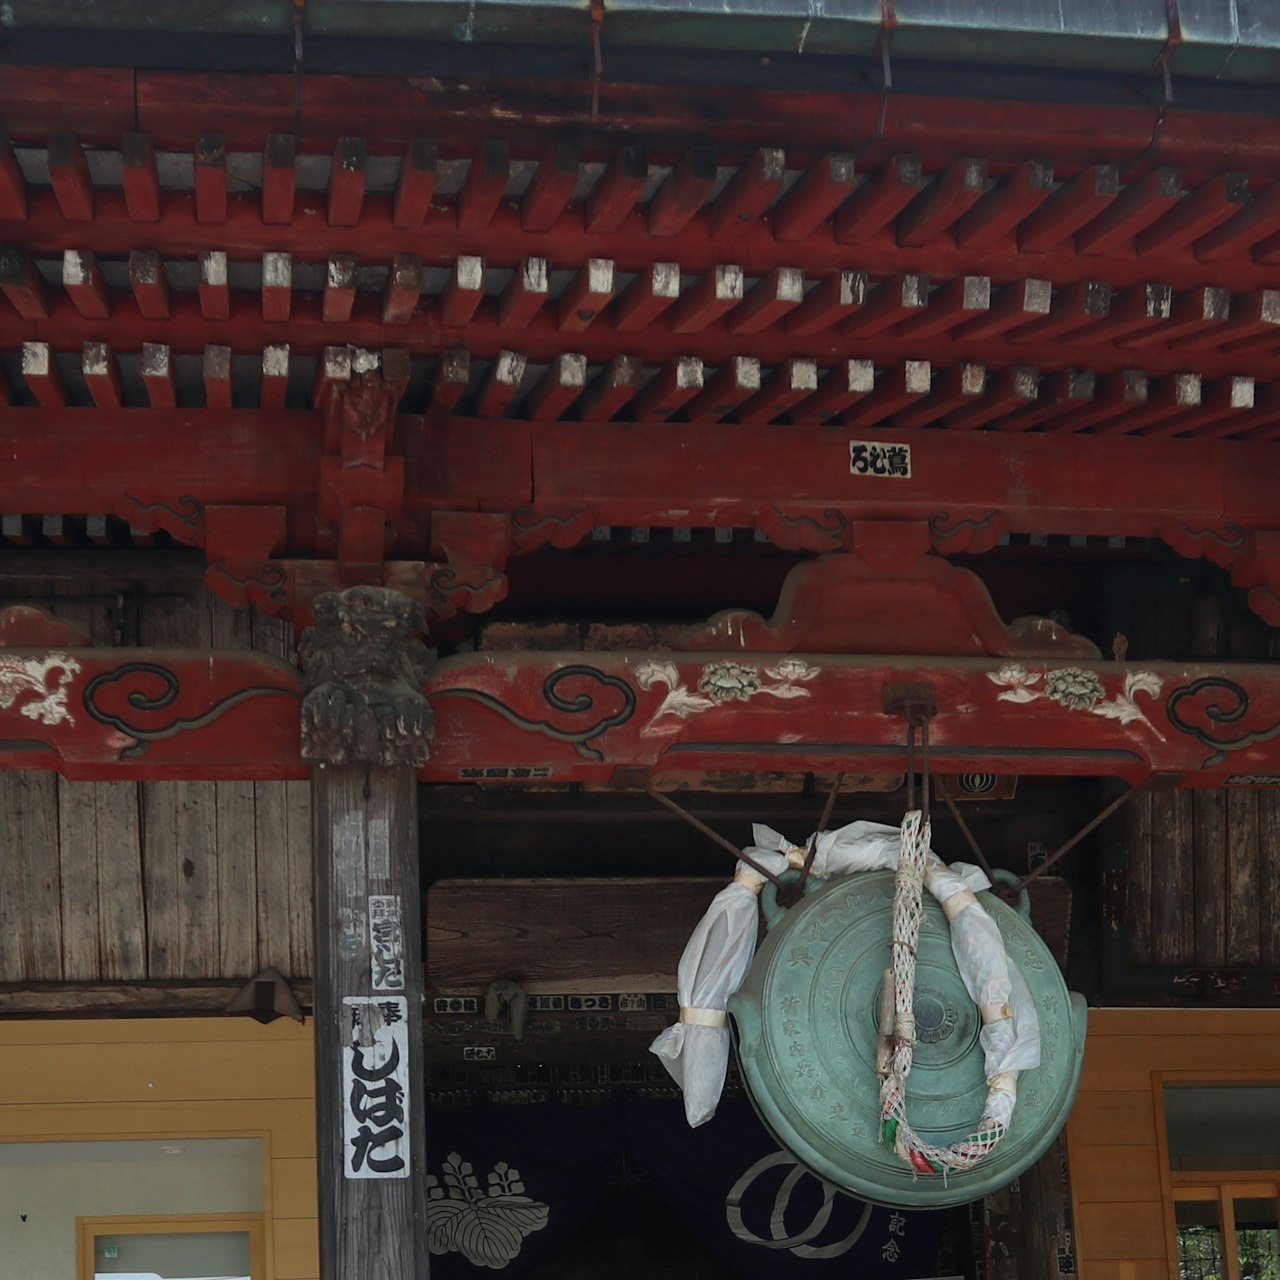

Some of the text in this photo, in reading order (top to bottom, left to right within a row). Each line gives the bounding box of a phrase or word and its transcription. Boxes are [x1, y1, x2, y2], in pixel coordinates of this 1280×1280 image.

[350, 1036, 406, 1173] しばた
[881, 1212, 907, 1263] 記念
